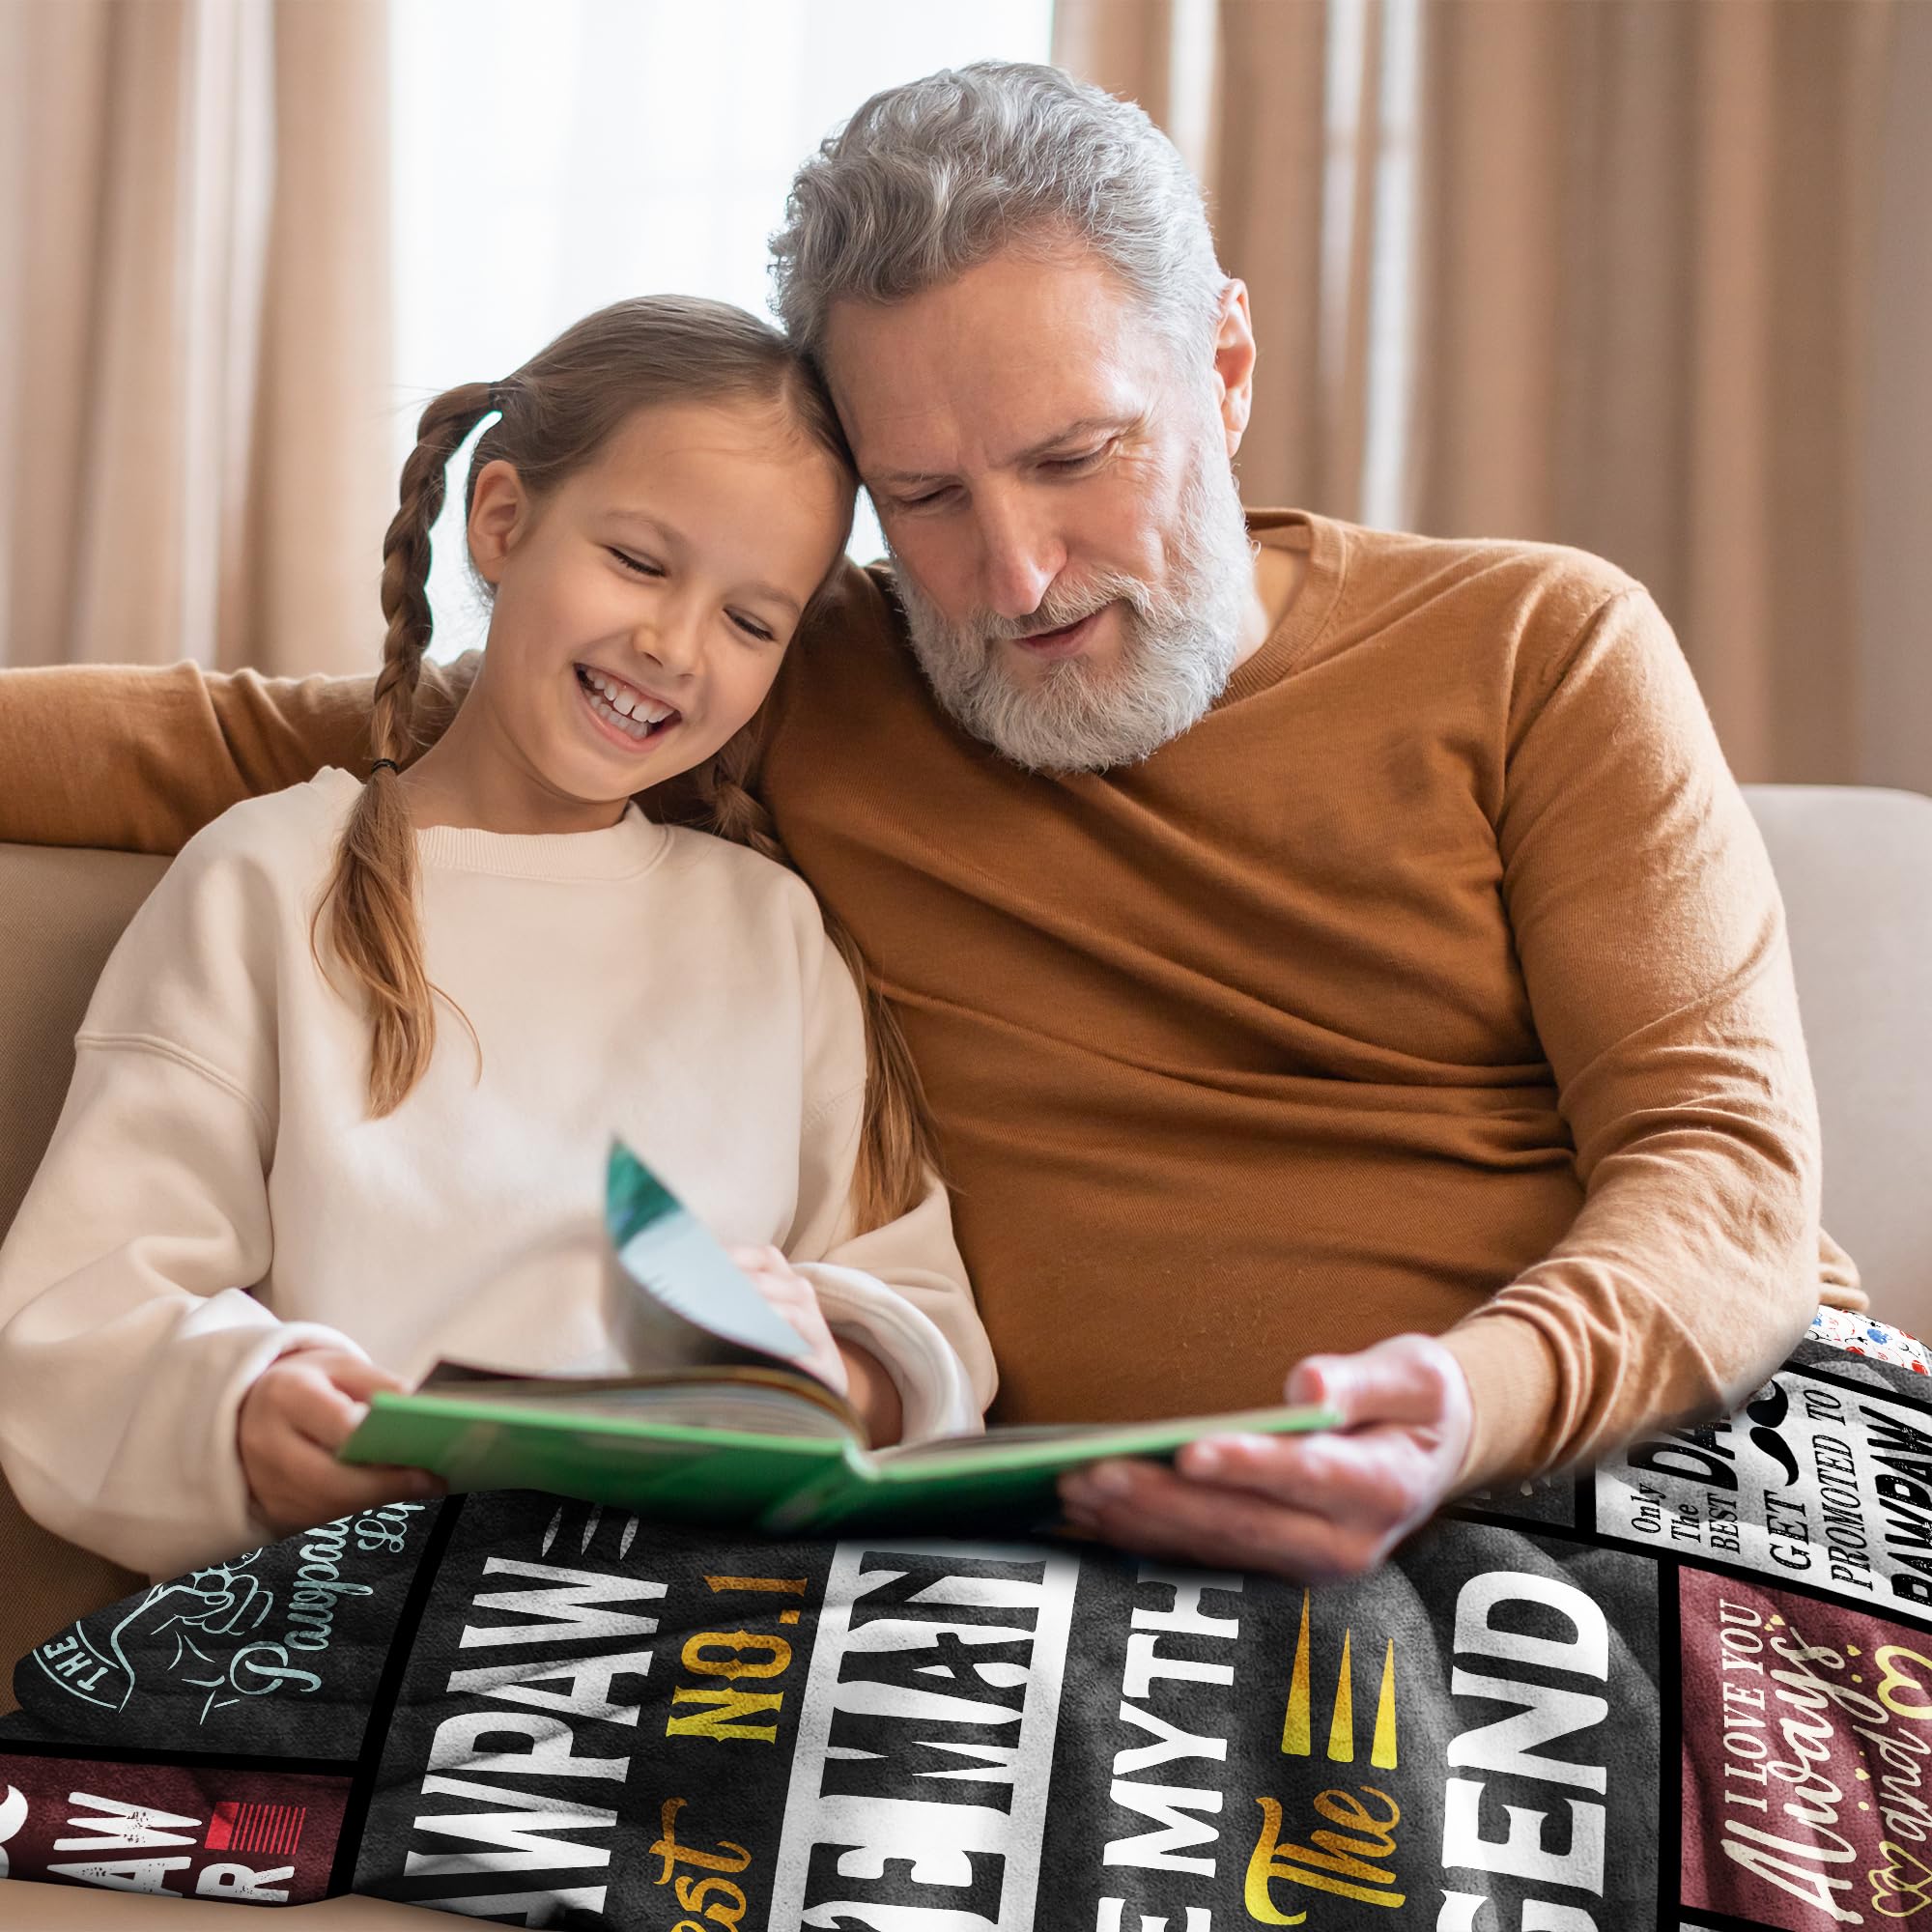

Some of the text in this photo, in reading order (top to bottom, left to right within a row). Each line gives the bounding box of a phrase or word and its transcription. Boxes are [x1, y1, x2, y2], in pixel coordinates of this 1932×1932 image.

[1631, 1483, 1667, 1534] Only
[1670, 1503, 1701, 1544] The
[1707, 1492, 1741, 1554] BEST
[1763, 1490, 1812, 1571] GET
[1803, 1389, 1873, 1592] PROMOTED TO
[43, 1635, 106, 1691] THE
[666, 1576, 809, 1744] NO.1
[818, 1550, 1046, 1817] MAN
[1102, 1564, 1245, 1878] MYTH
[1719, 1599, 1769, 1813] I LOVE YOU
[1719, 1626, 1889, 1925] Always
[1852, 1724, 1932, 1842] and
[1244, 1785, 1406, 1925] The
